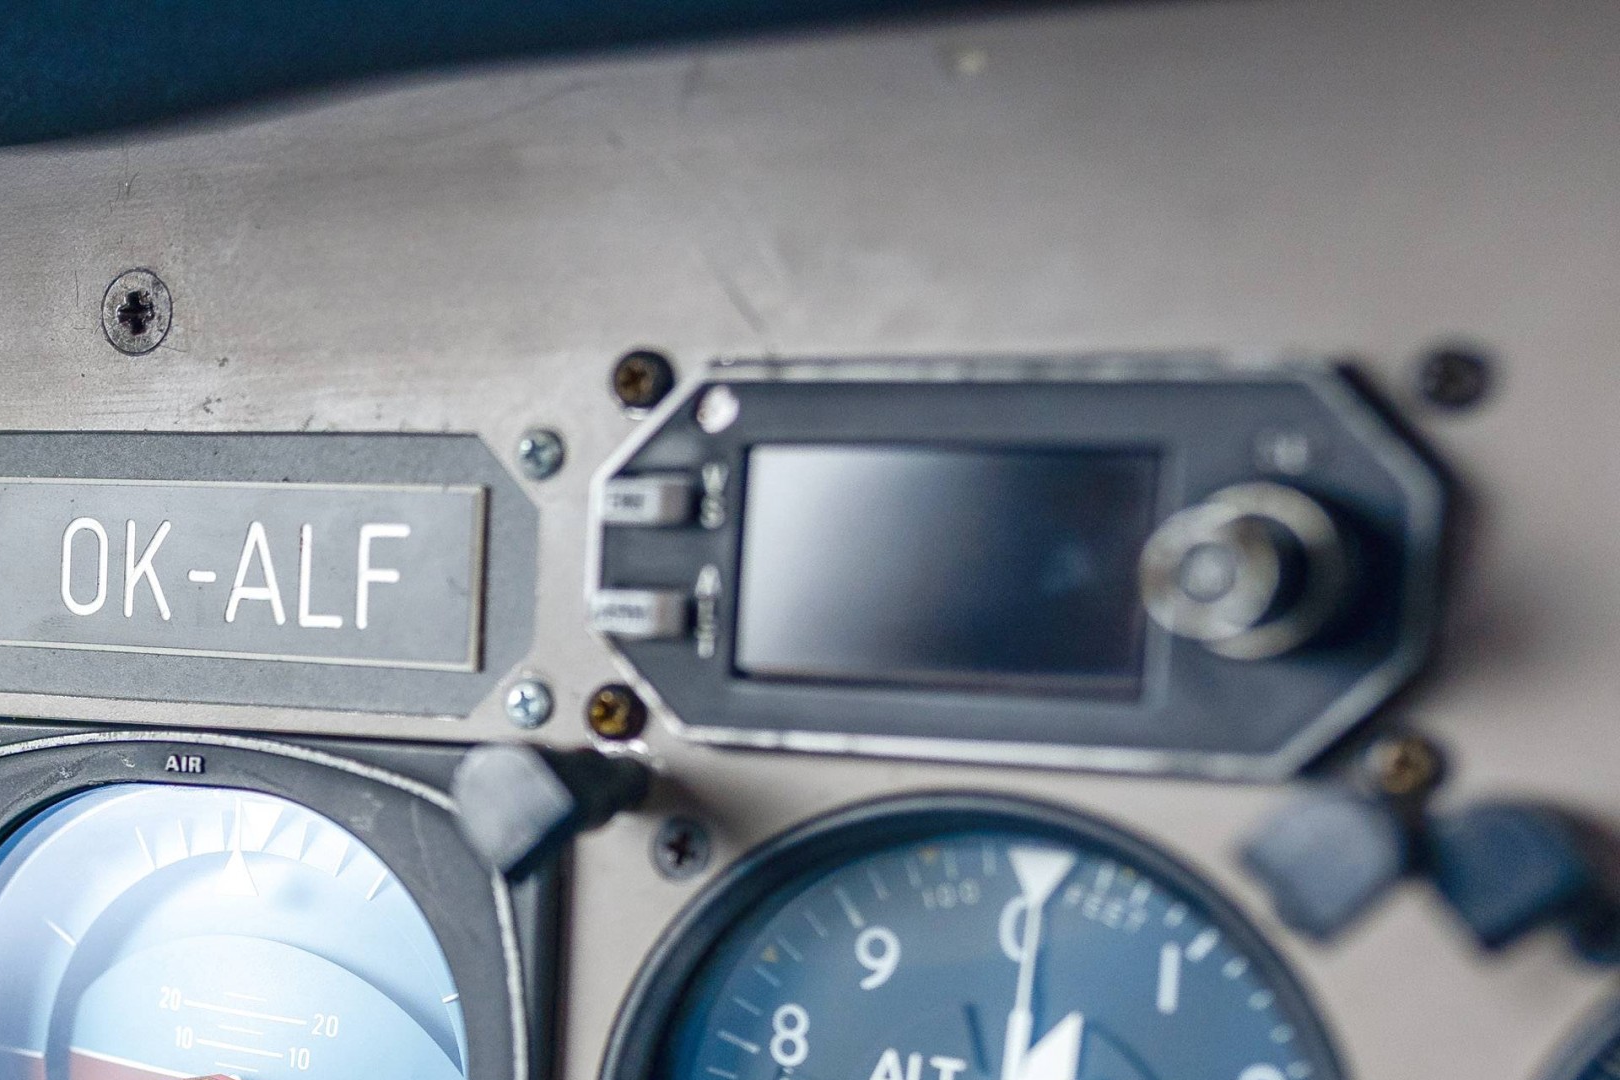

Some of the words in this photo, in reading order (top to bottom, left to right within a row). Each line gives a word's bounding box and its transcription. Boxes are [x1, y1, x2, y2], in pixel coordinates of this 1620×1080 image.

[61, 517, 410, 630] OK-ALF
[165, 754, 206, 773] AIR
[855, 926, 901, 990] 9
[1157, 943, 1179, 1014] 1
[158, 984, 181, 1012] 20
[175, 1025, 193, 1050] 10
[312, 1014, 339, 1038] 20
[770, 1003, 810, 1066] 8
[289, 1047, 310, 1071] 10
